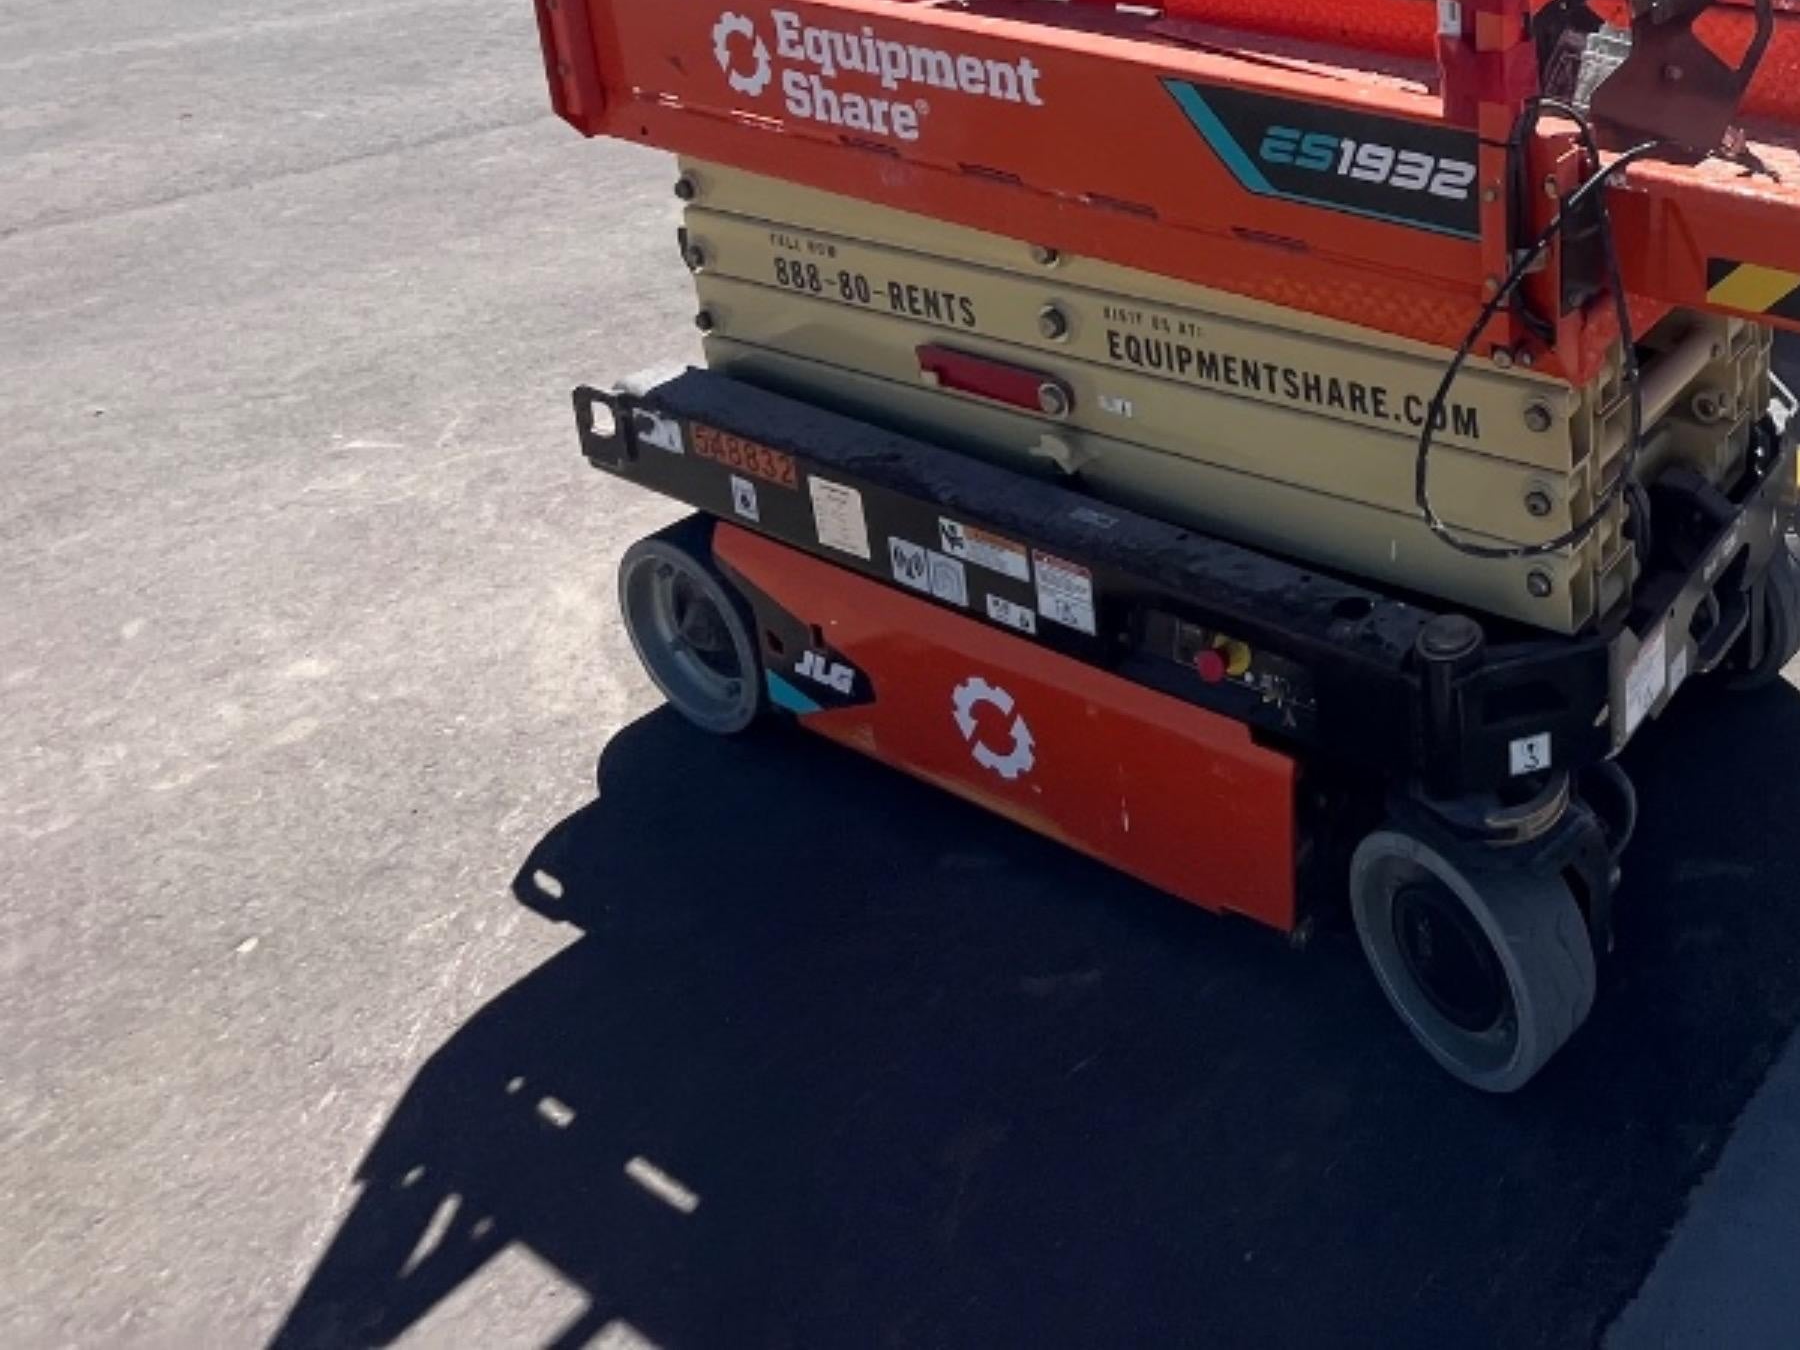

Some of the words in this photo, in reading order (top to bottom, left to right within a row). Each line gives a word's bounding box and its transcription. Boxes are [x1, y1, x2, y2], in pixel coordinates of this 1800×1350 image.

[771, 8, 1044, 106] Equipment
[1259, 125, 1477, 200] ES1932
[773, 256, 977, 328] 888-80-RENTS
[1105, 329, 1480, 439] EQUIPMENTSHARE.COM
[694, 425, 794, 484] 548832
[794, 650, 856, 695] JLG
